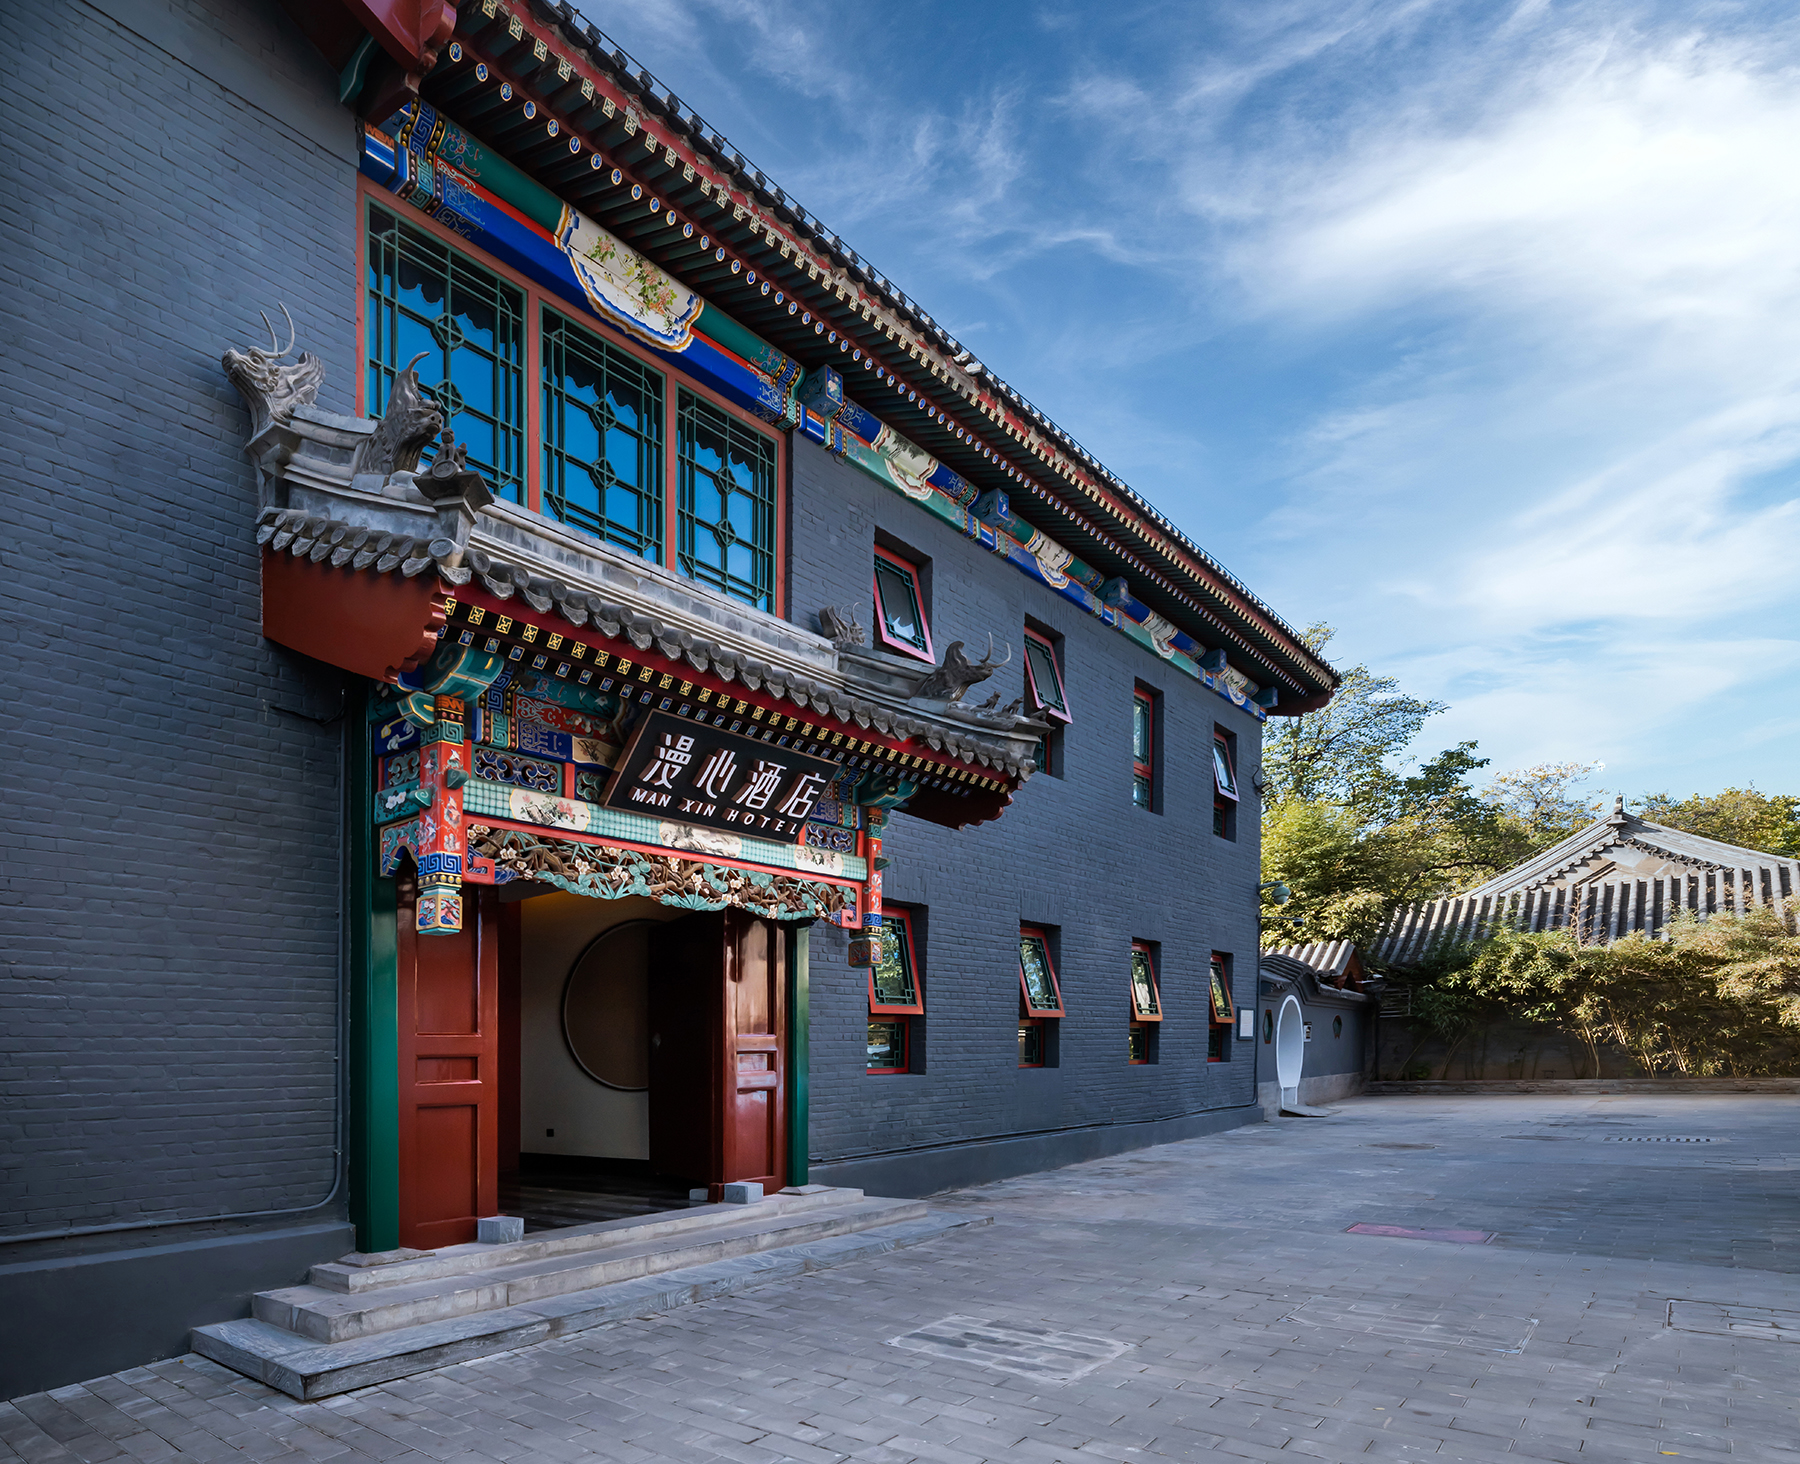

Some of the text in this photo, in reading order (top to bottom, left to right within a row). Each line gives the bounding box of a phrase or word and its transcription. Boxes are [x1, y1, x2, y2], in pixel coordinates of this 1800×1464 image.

[641, 733, 827, 819] 漫心酒店
[631, 787, 798, 835] MAN XIN HOTEL
